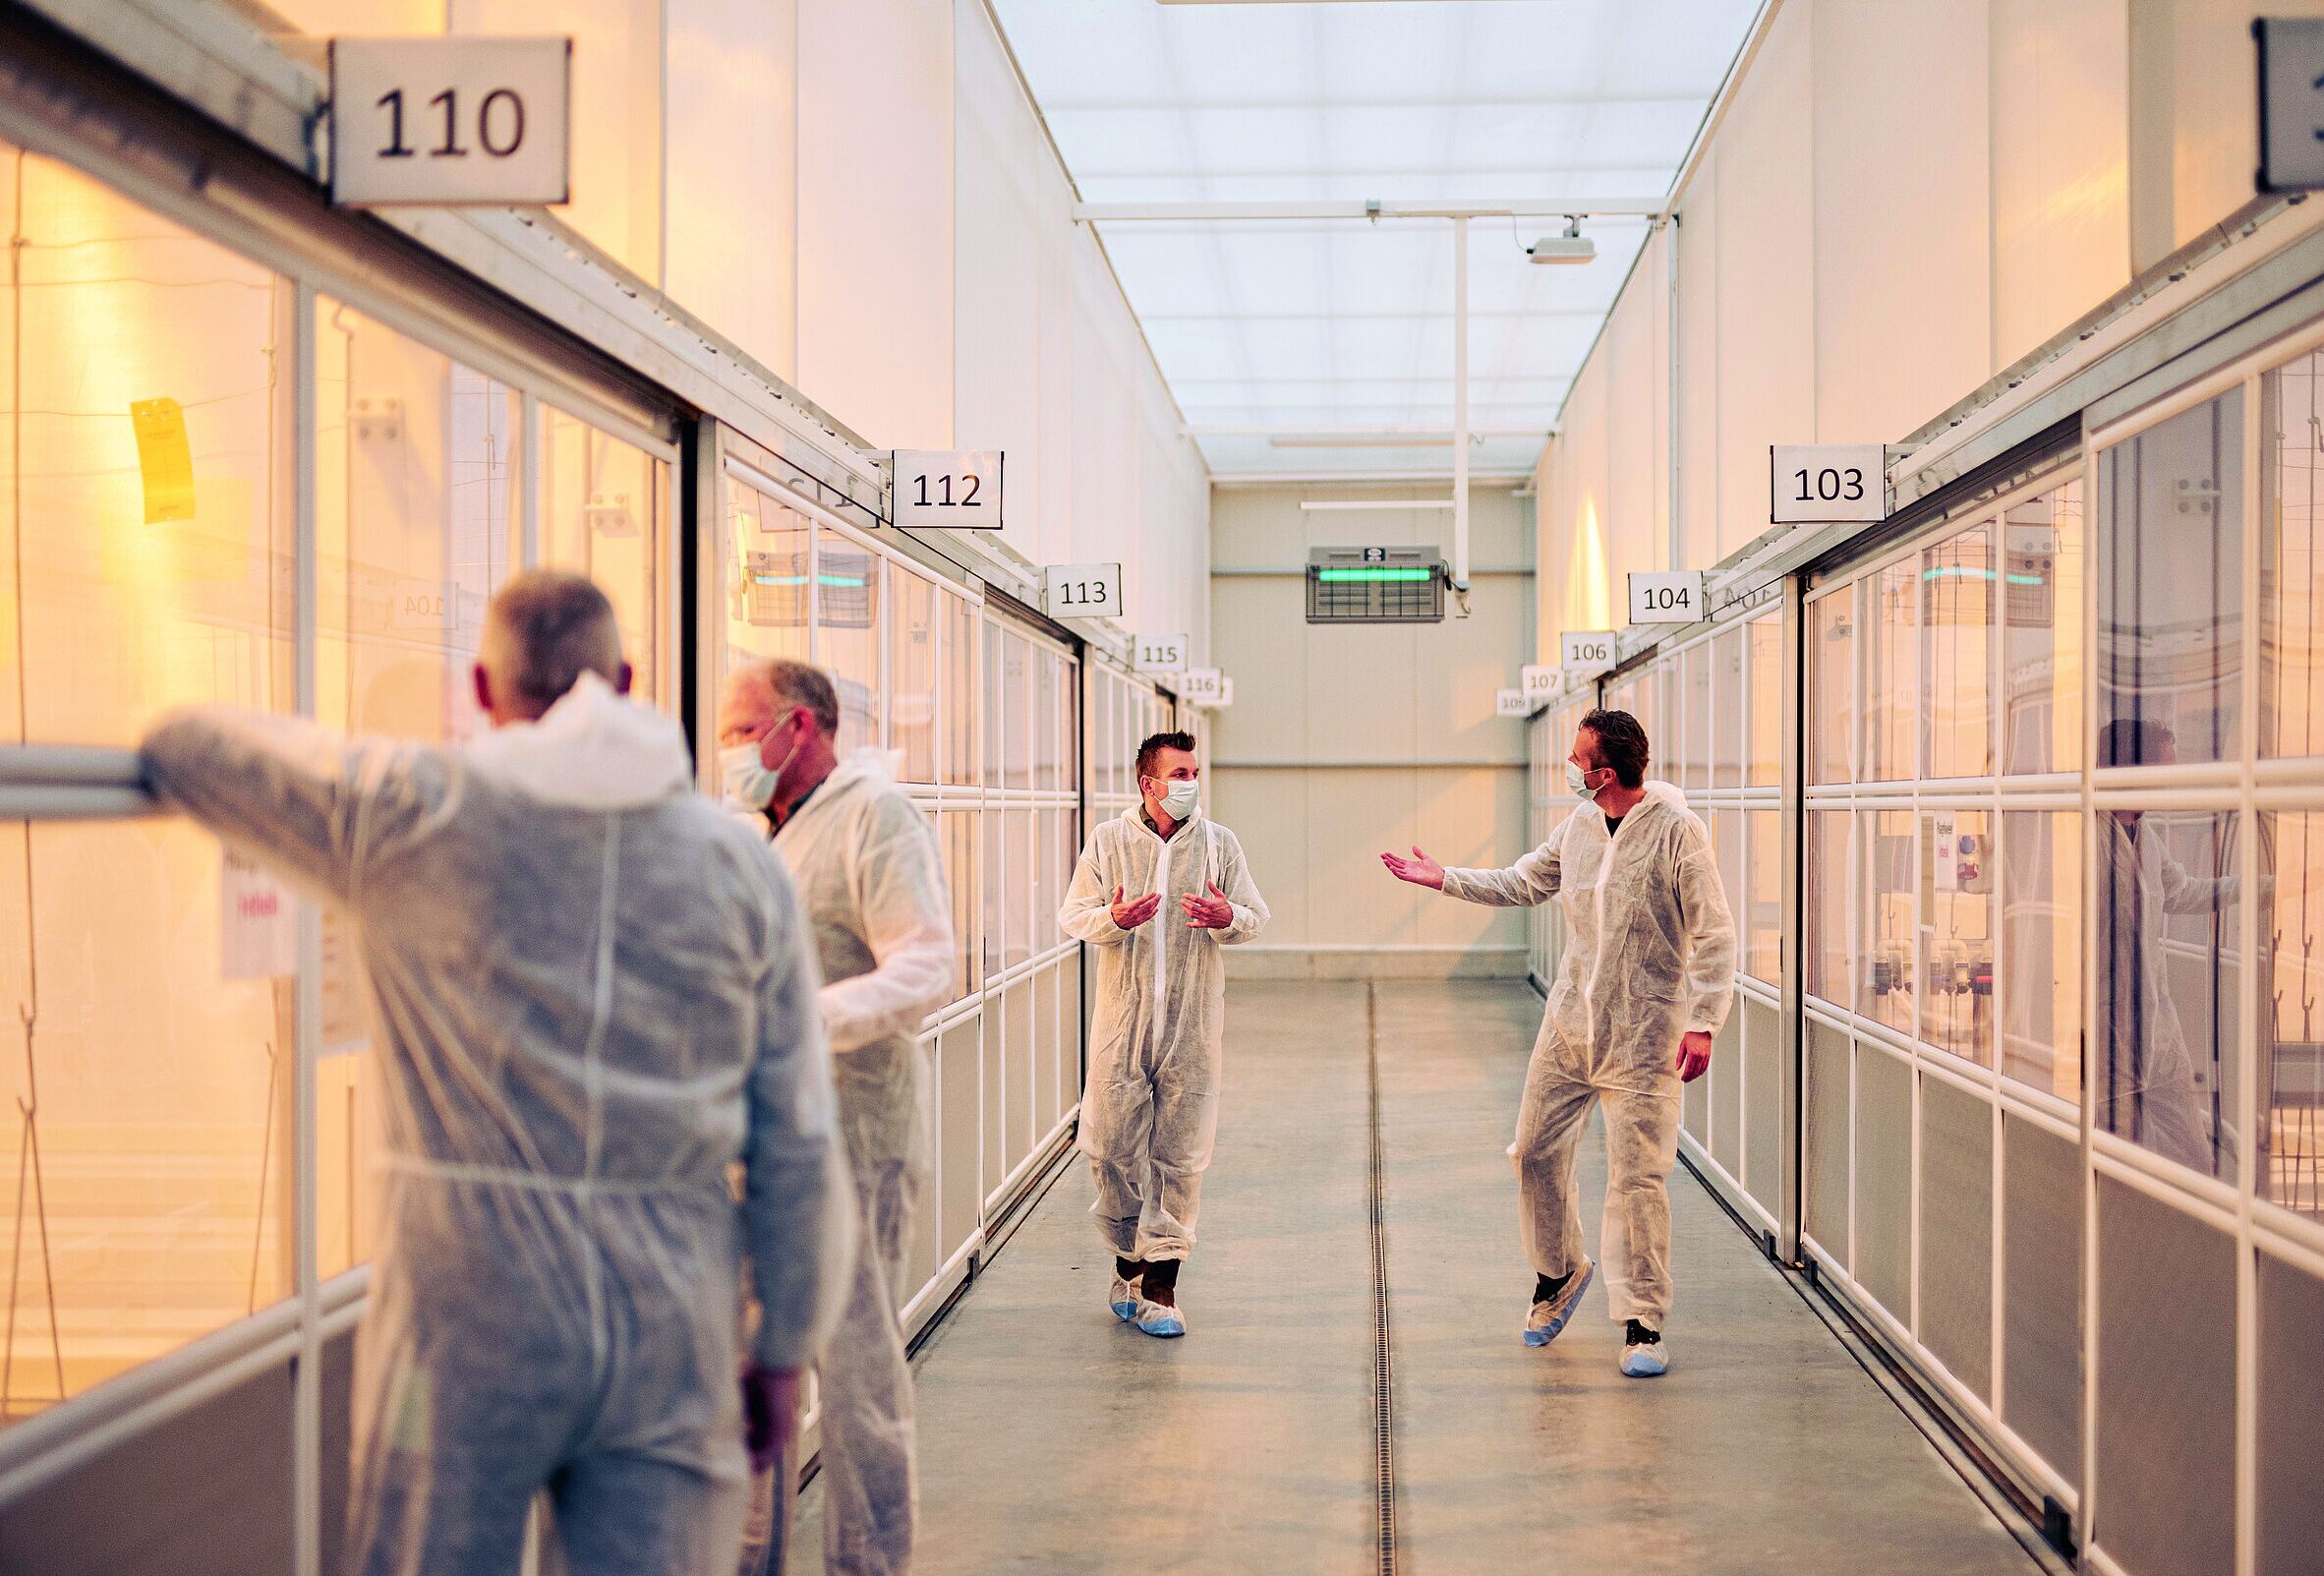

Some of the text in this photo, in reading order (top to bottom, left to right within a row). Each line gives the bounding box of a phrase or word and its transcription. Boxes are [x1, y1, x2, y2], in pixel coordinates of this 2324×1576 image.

[377, 88, 525, 158] 110
[913, 474, 982, 507] 112
[1794, 468, 1864, 501] 103
[1061, 581, 1107, 605] 113
[1644, 587, 1691, 610] 104
[1144, 646, 1178, 663] 115
[1572, 644, 1607, 661] 106
[1187, 677, 1214, 692] 116
[1531, 674, 1558, 689] 107
